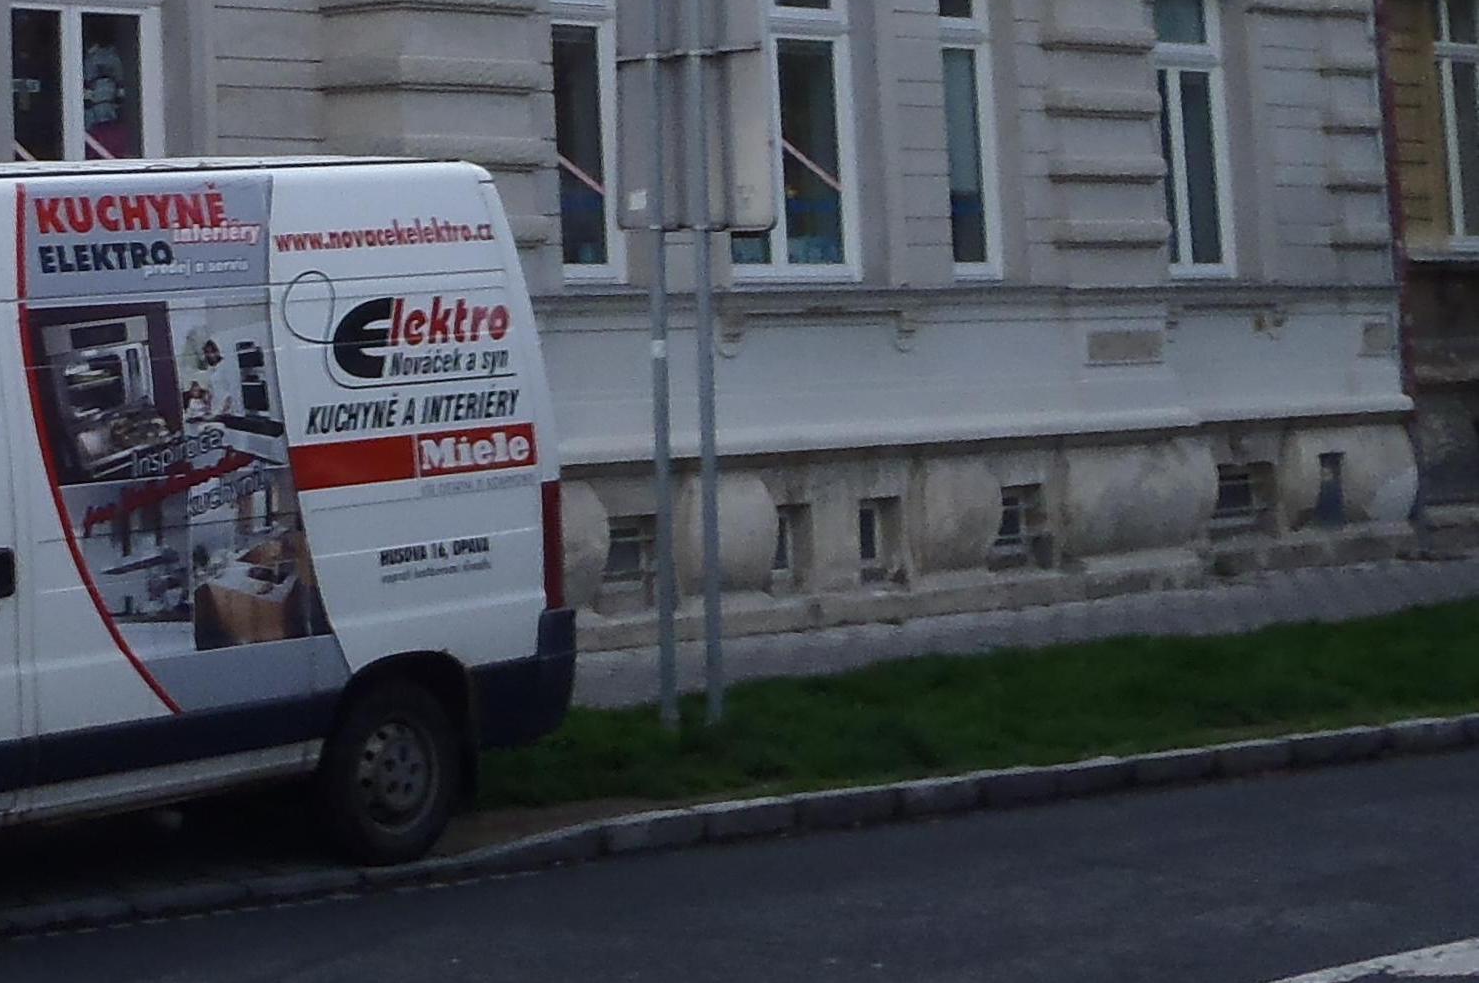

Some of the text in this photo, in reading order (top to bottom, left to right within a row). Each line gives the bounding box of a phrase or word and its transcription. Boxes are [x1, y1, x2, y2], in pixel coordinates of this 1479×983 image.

[35, 182, 224, 233] KUCHYNĚ
[274, 217, 495, 252] www.novacekelektro.cz
[38, 241, 173, 274] ELEKTRO
[334, 296, 510, 379] Elektro
[389, 348, 509, 376] Nováček a syn
[306, 384, 520, 435] KUCHYNĚ A INTERIÉRY
[420, 432, 530, 470] Miele
[380, 545, 428, 566] HUSOVA
[453, 536, 490, 556] OPAVA
